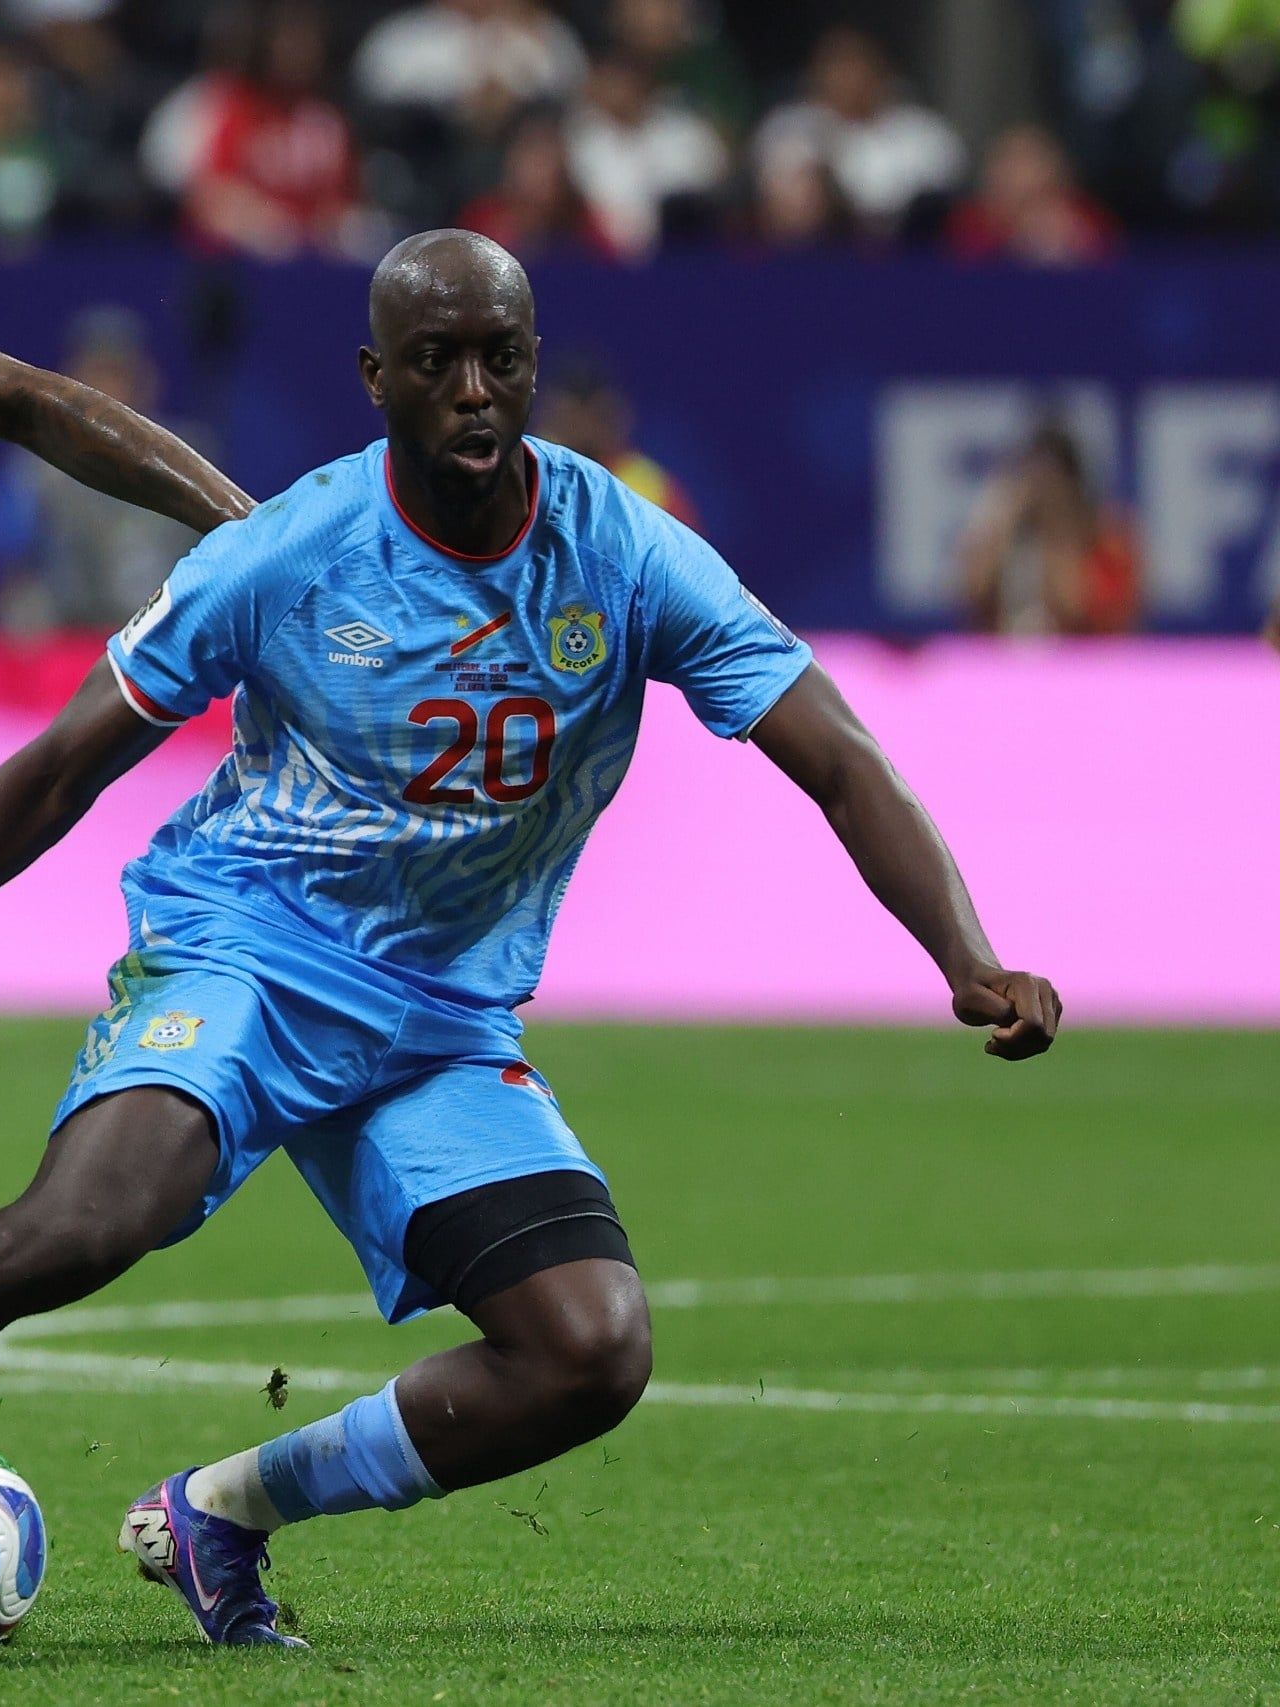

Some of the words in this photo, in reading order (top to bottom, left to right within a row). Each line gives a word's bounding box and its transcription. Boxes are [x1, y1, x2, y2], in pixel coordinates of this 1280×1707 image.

[874, 378, 1280, 612] FF
[328, 652, 384, 668] umbro
[560, 653, 600, 669] FECOFA
[402, 695, 557, 806] 20
